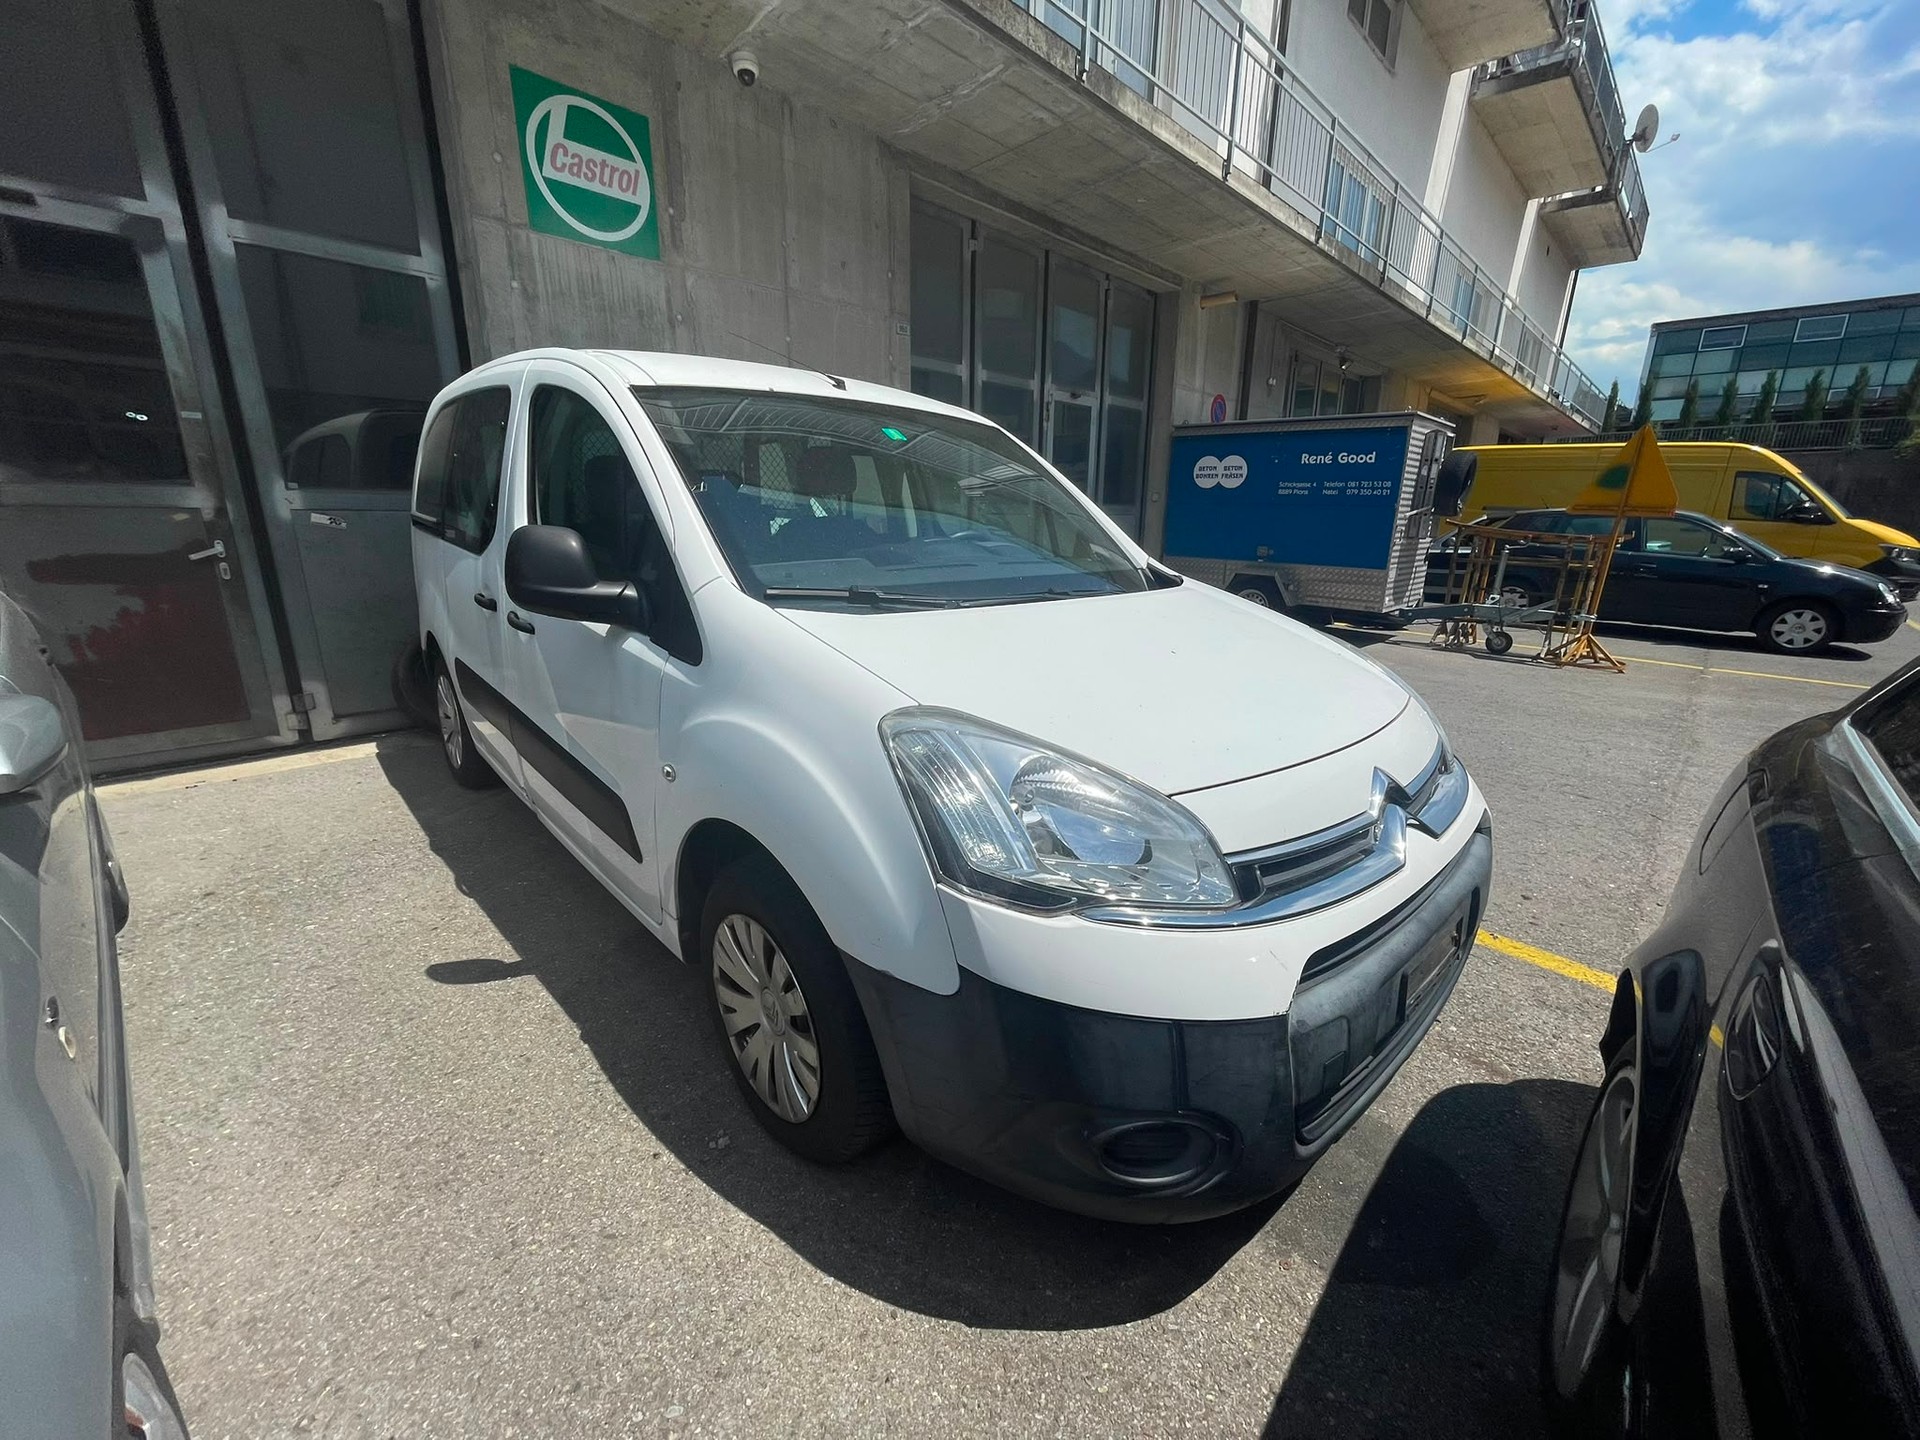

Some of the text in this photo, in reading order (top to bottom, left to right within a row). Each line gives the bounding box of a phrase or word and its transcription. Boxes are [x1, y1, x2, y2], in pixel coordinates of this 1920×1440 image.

[550, 142, 640, 196] Castrol
[1301, 451, 1376, 464] René Good
